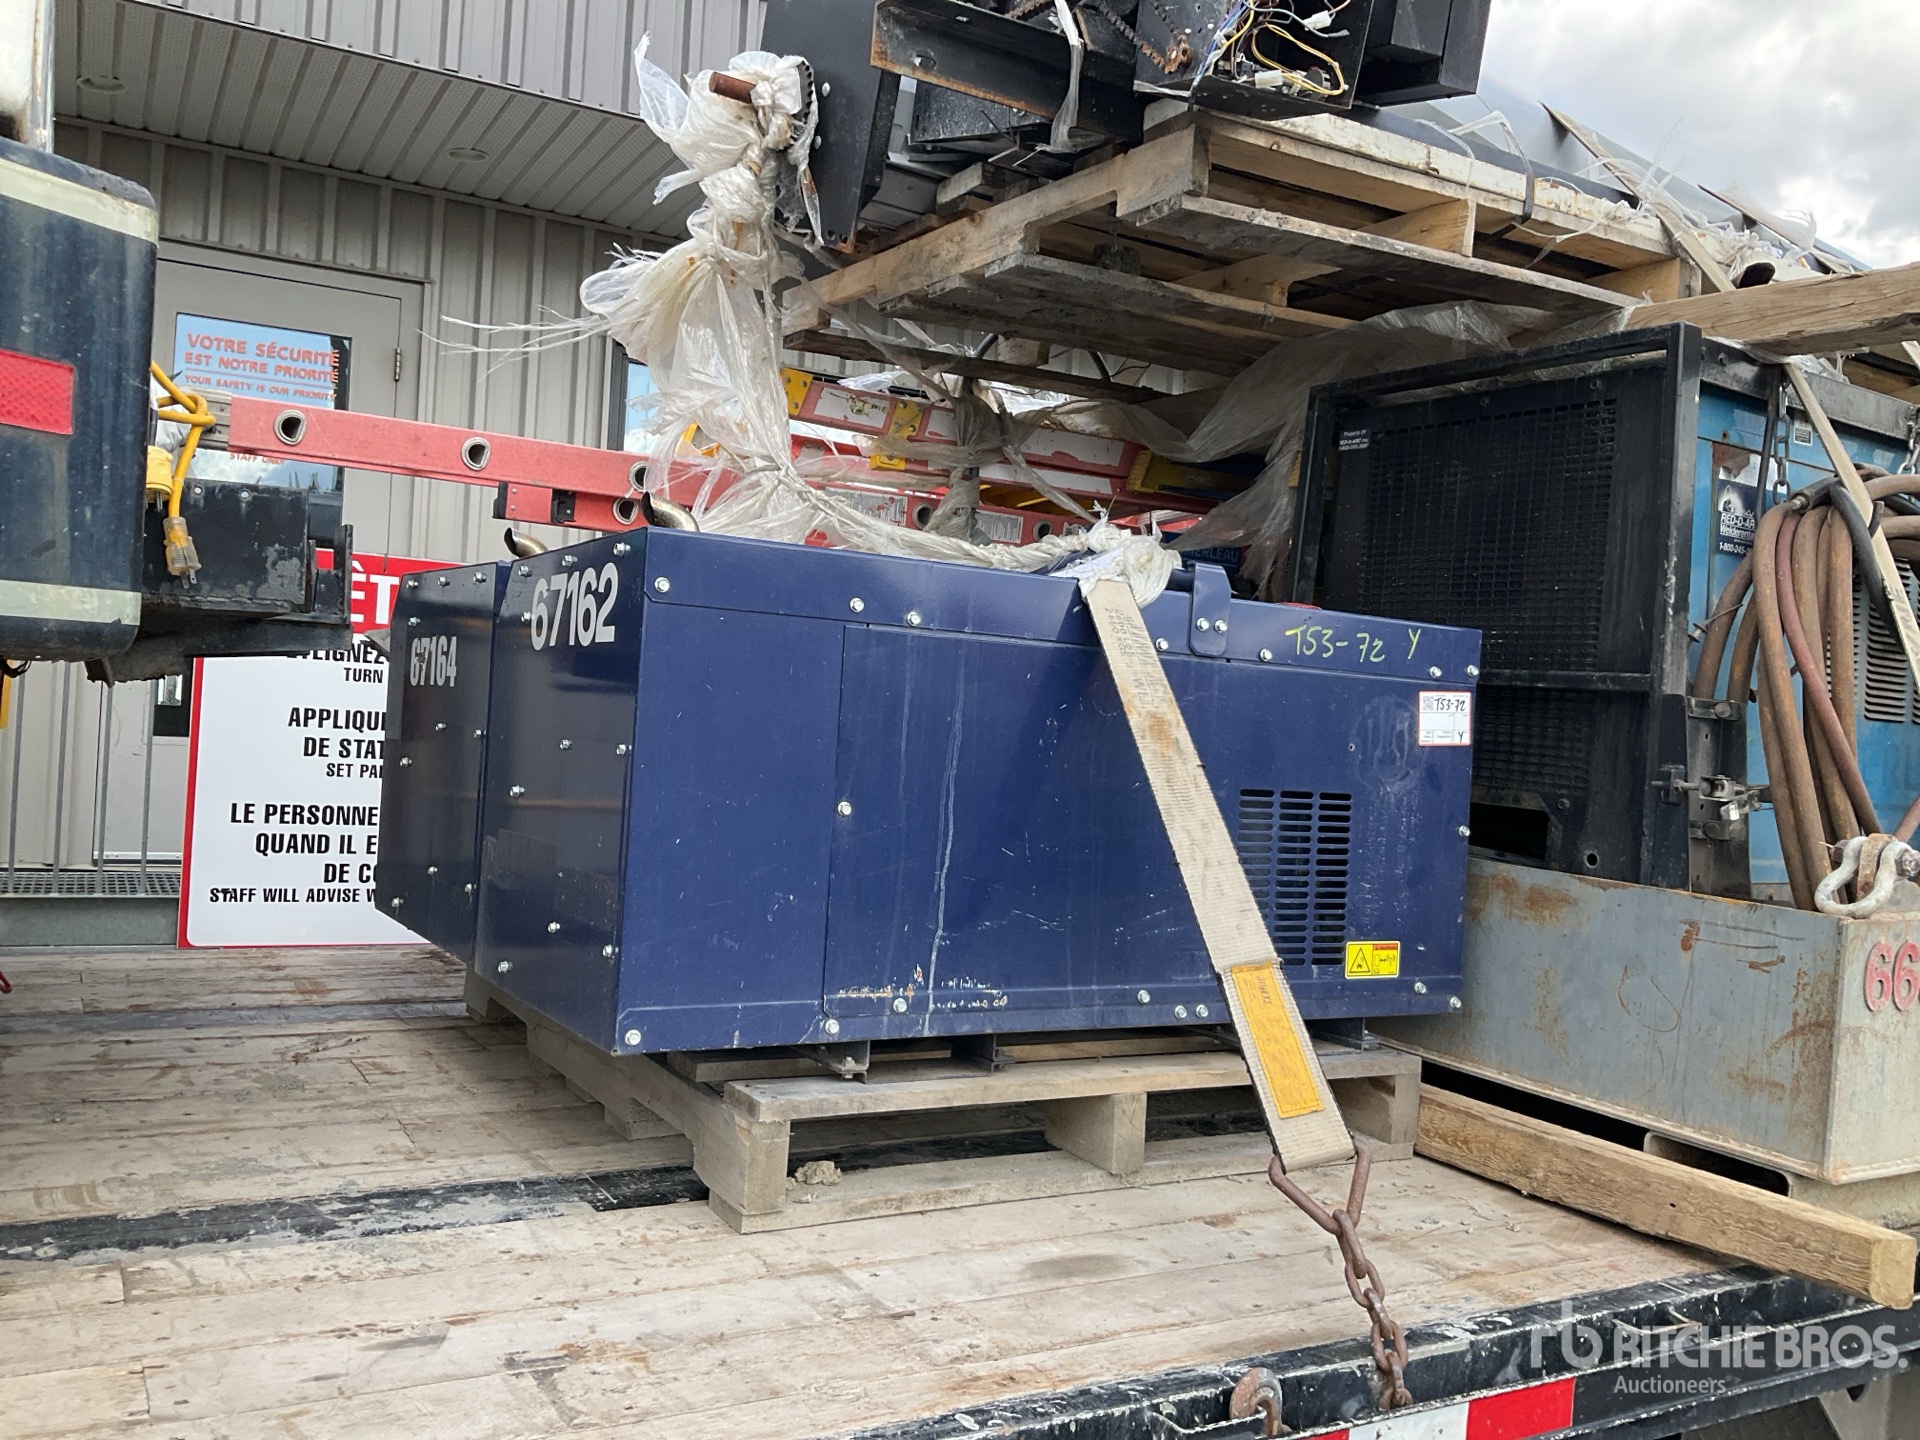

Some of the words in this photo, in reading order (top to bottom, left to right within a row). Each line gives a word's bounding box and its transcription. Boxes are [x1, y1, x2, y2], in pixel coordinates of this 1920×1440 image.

[187, 334, 248, 354] VOTRE
[184, 352, 212, 366] EST
[218, 357, 268, 373] NOTRE
[184, 374, 211, 385] YOUR
[216, 378, 252, 391] SAFETY
[269, 386, 290, 395] OUR
[293, 389, 337, 401] PRIORITY
[229, 453, 257, 463] STAFF
[531, 562, 619, 650] 67162
[1408, 629, 1421, 660] Y
[410, 635, 457, 687] 67164
[344, 667, 383, 684] TURN
[303, 737, 330, 757] DE
[326, 762, 354, 778] SET
[360, 764, 383, 778] PA
[230, 803, 255, 823] LE
[264, 804, 379, 826] PERSONNE
[255, 833, 330, 856] QUAND
[339, 834, 357, 854] IL
[324, 863, 350, 883] DE
[358, 863, 377, 883] C
[210, 887, 257, 902] STAFF
[263, 888, 300, 902] WILL
[306, 888, 360, 902] ADVISE
